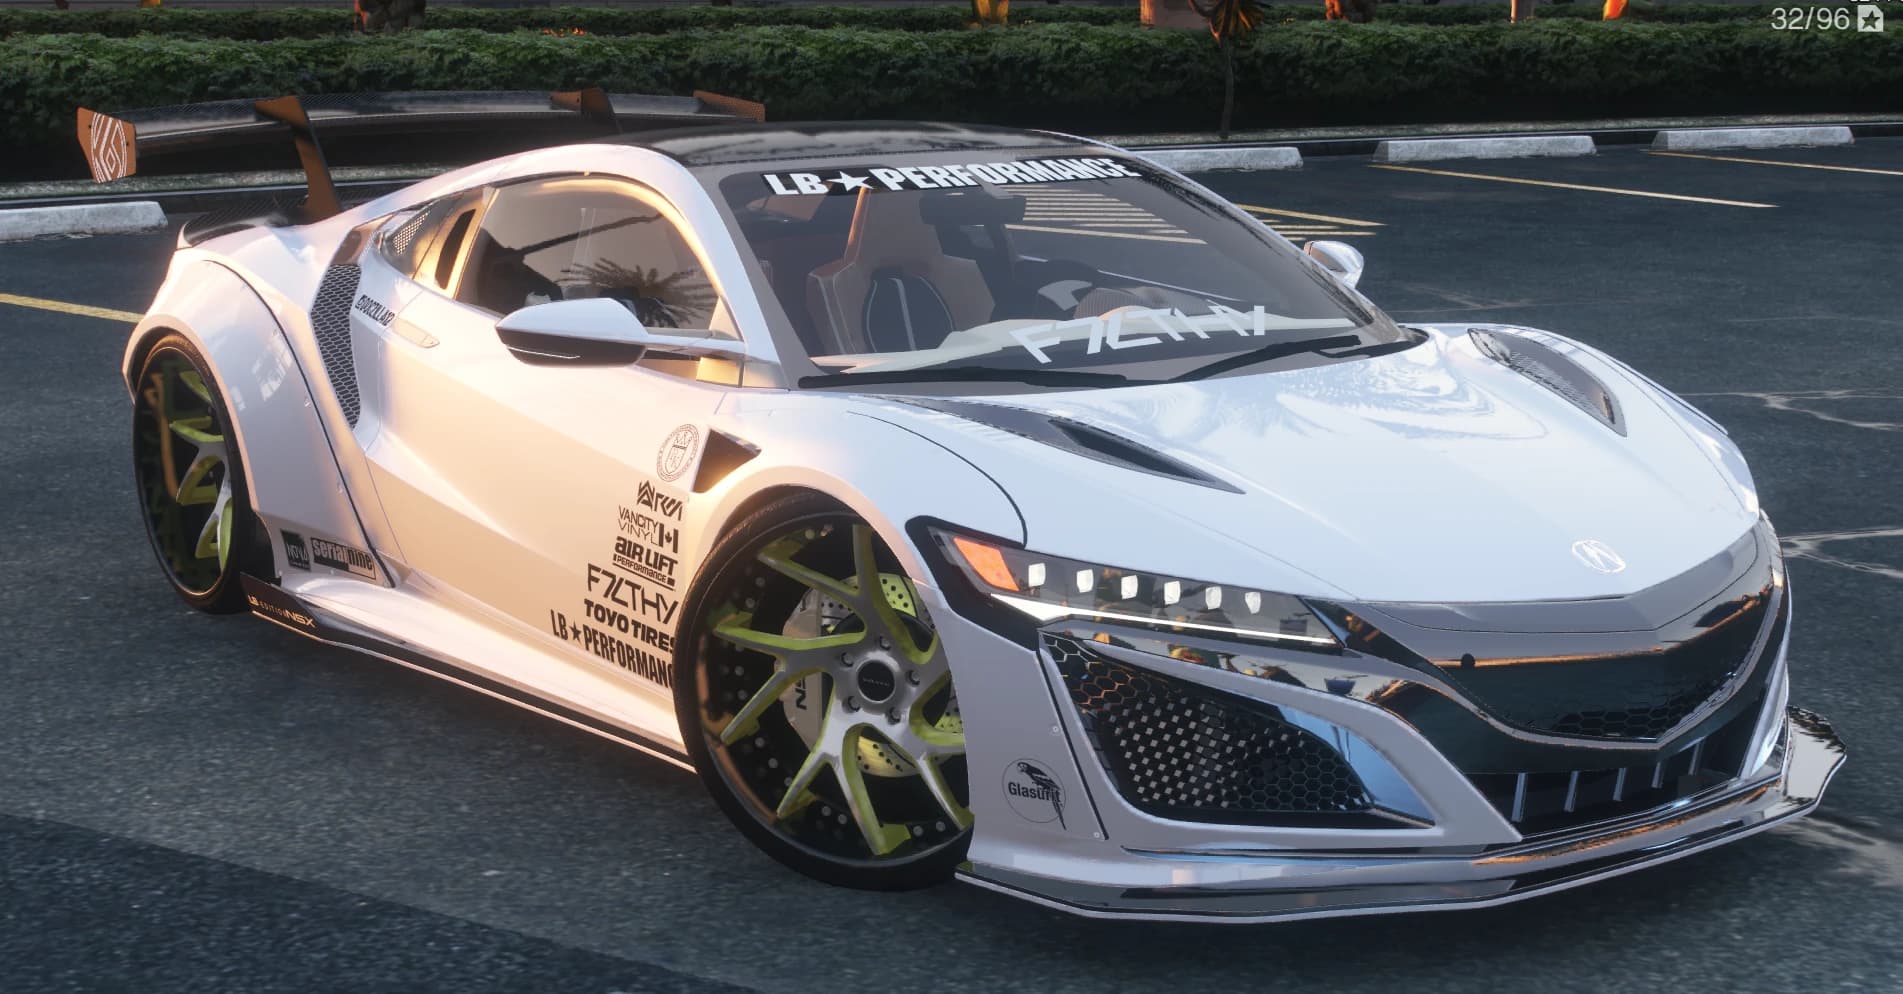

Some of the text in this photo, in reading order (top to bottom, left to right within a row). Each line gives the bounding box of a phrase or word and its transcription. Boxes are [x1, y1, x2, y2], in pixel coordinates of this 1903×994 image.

[763, 157, 1142, 195] LB PERFORMANCE
[617, 518, 660, 547] VINYL
[618, 504, 660, 534] VANCITY
[644, 547, 679, 577] LIFT
[550, 608, 569, 642] LB
[584, 598, 630, 634] TOYO
